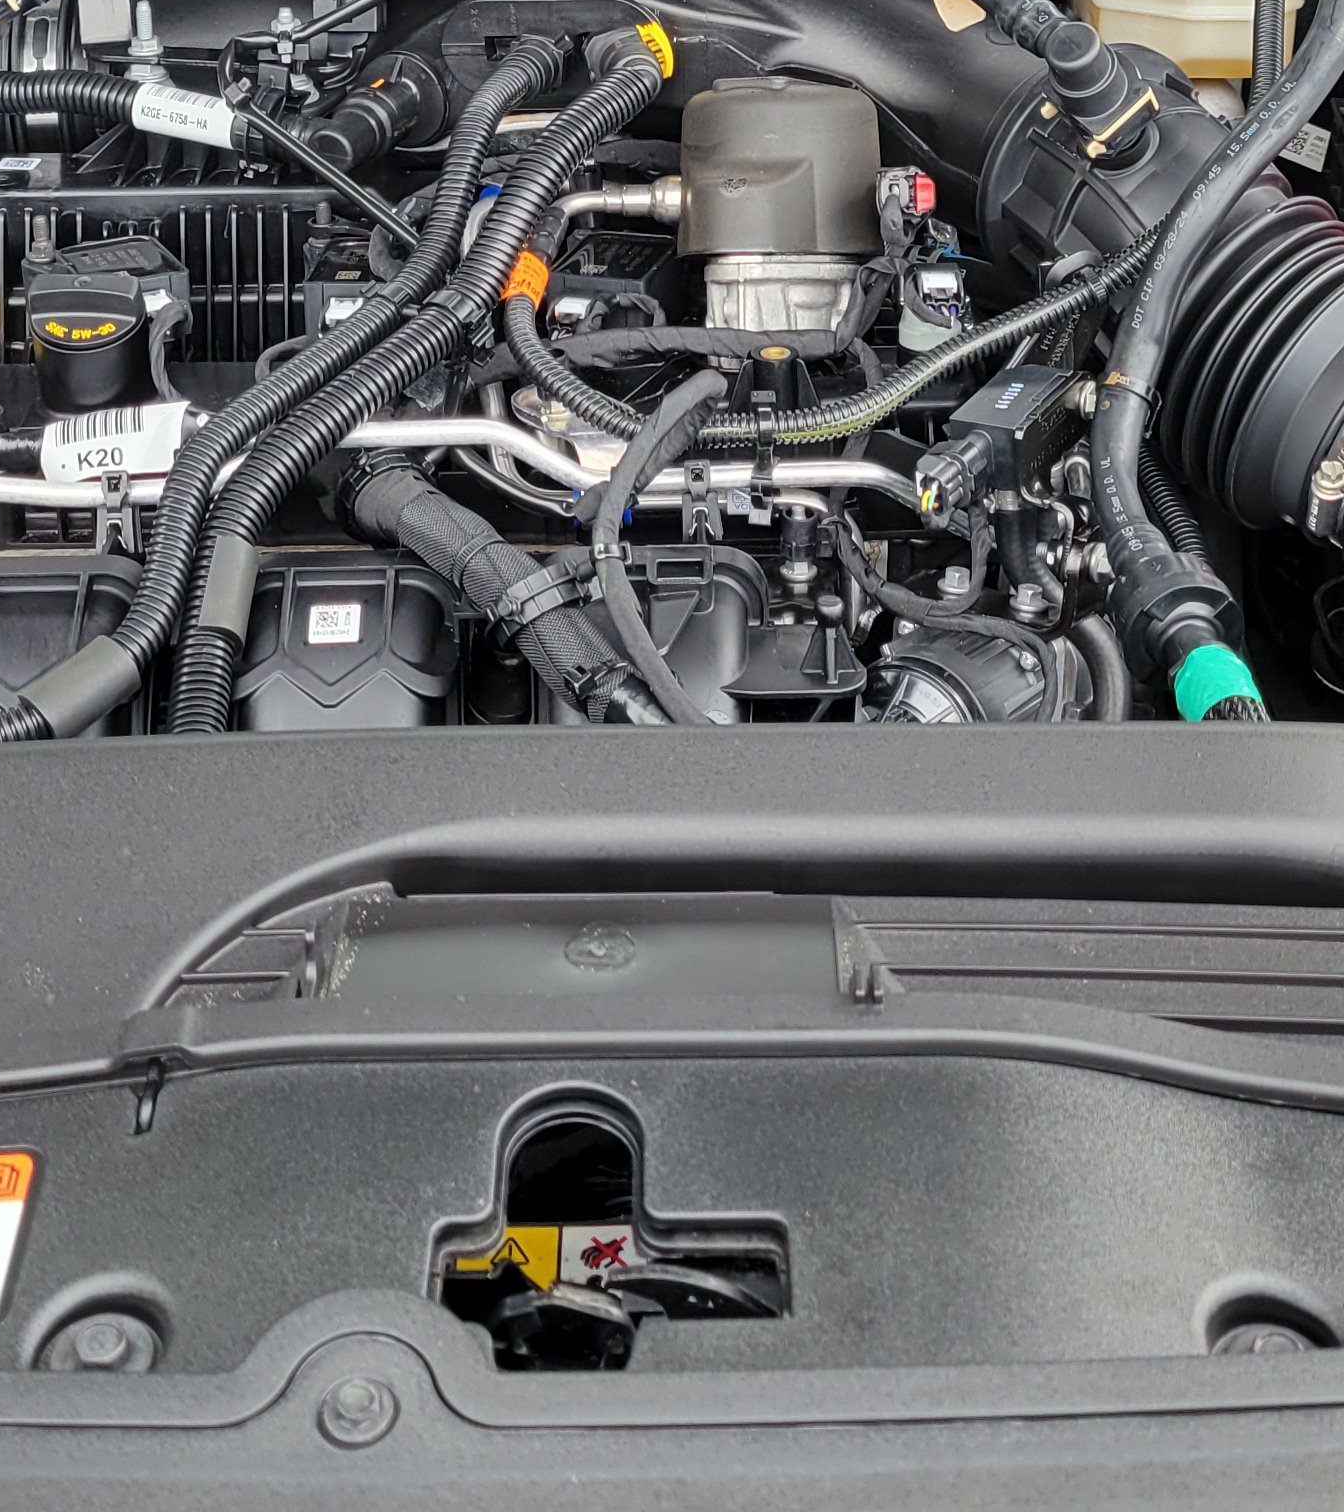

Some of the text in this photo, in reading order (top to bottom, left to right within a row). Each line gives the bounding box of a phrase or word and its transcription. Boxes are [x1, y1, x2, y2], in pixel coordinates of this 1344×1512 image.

[1131, 305, 1145, 330] DOT
[1140, 276, 1155, 303] CIP
[1153, 210, 1190, 272] 03/28/24
[1192, 164, 1223, 201] 09:45
[1281, 79, 1298, 95] UL
[44, 320, 117, 340] SAE 5W-30
[77, 446, 124, 472] K20
